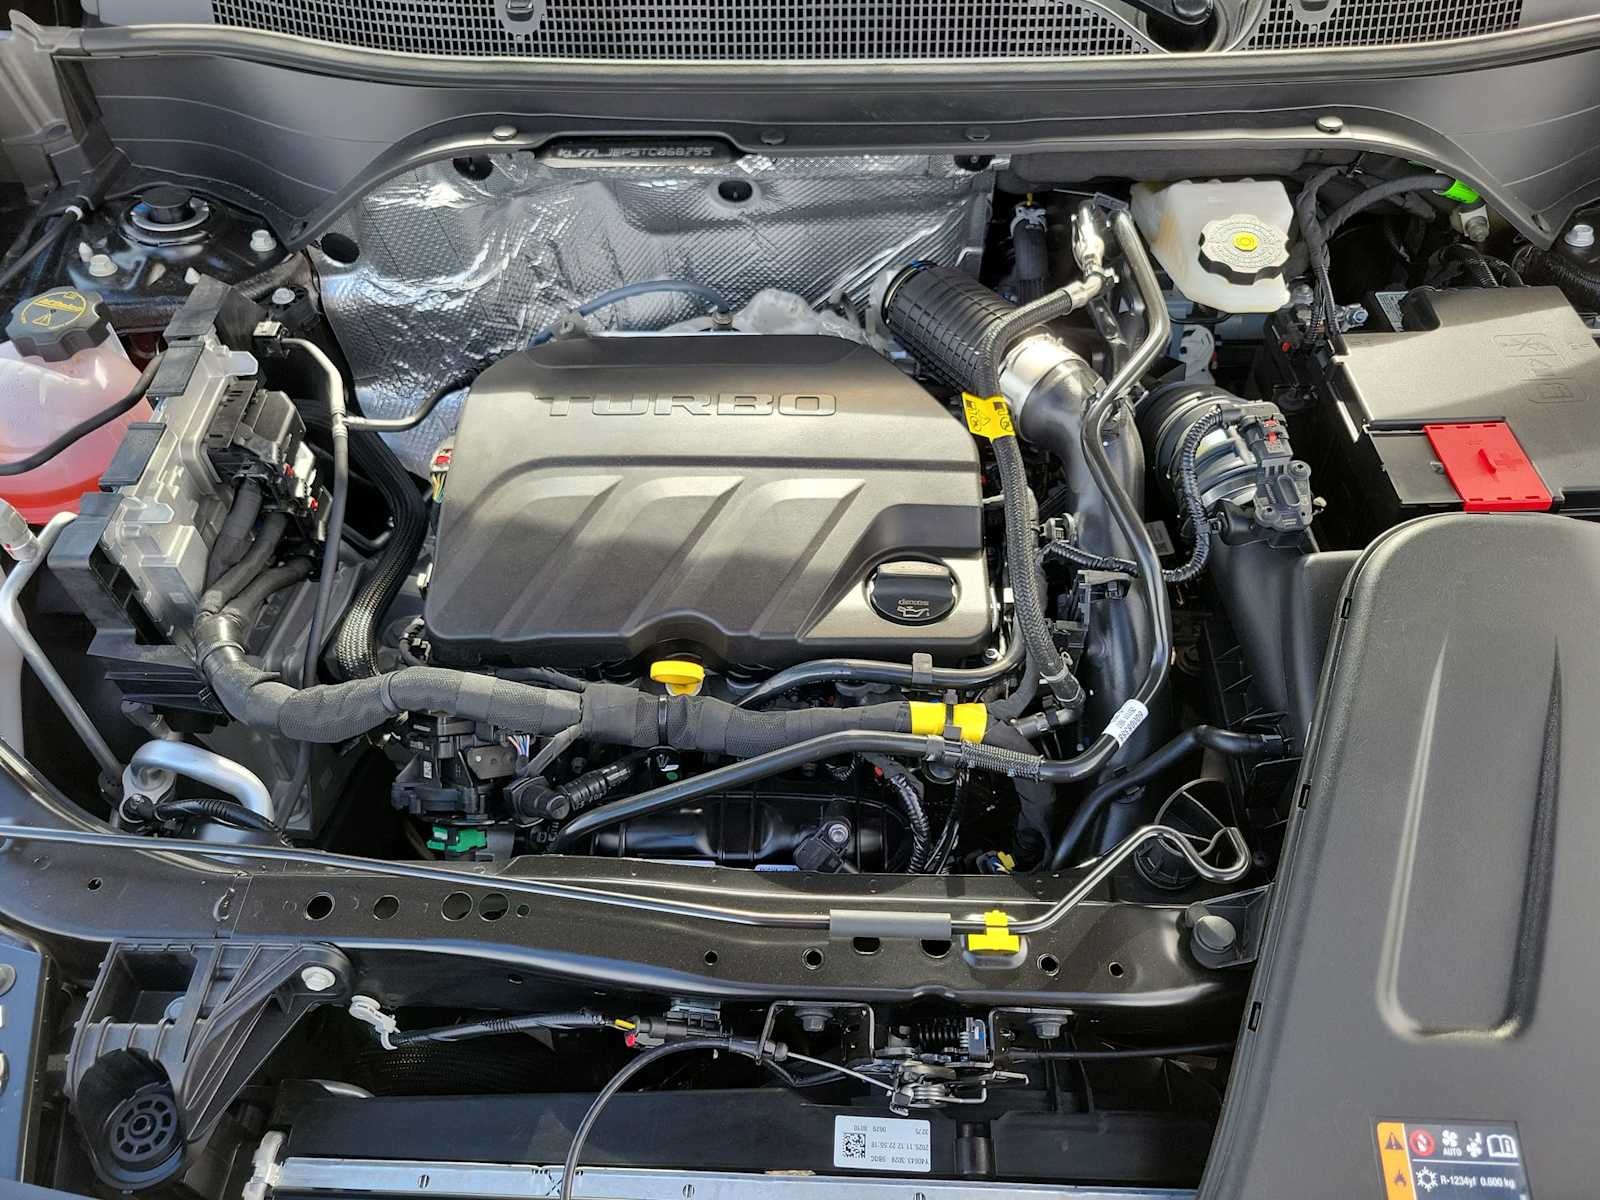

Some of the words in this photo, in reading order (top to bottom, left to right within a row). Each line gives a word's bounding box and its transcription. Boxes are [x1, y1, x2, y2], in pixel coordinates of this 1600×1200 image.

[535, 393, 837, 417] TURBO
[1442, 1147, 1462, 1157] AUTO
[1440, 1174, 1477, 1188] R-1234yf
[1503, 1177, 1516, 1189] kg
